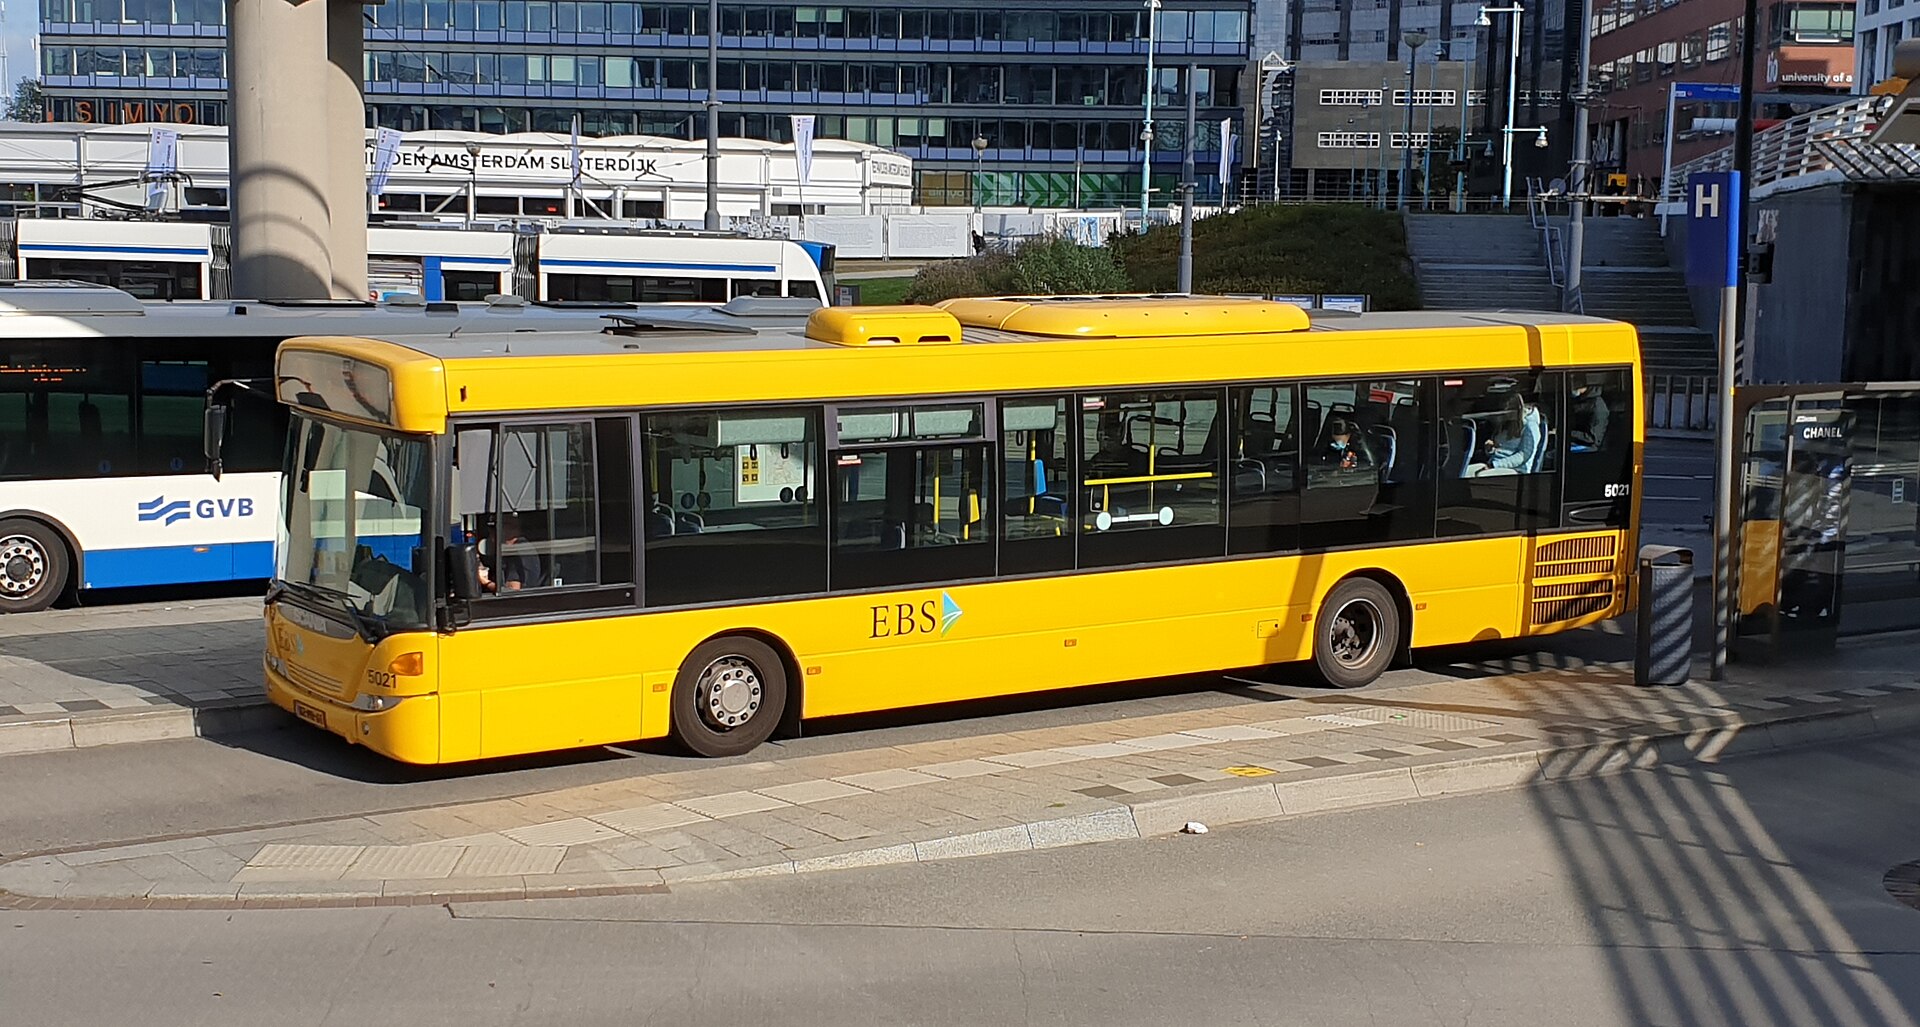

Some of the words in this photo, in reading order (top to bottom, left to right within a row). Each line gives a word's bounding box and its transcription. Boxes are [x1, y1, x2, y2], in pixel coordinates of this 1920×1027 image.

[1782, 72, 1830, 84] university
[1833, 72, 1845, 83] of
[77, 101, 194, 125] SIMYO
[1695, 184, 1719, 218] H
[1803, 427, 1842, 439] CHANEL
[1604, 483, 1629, 498] 5021
[196, 497, 254, 519] GVB
[868, 600, 936, 639] EBS
[368, 669, 397, 689] 5021
